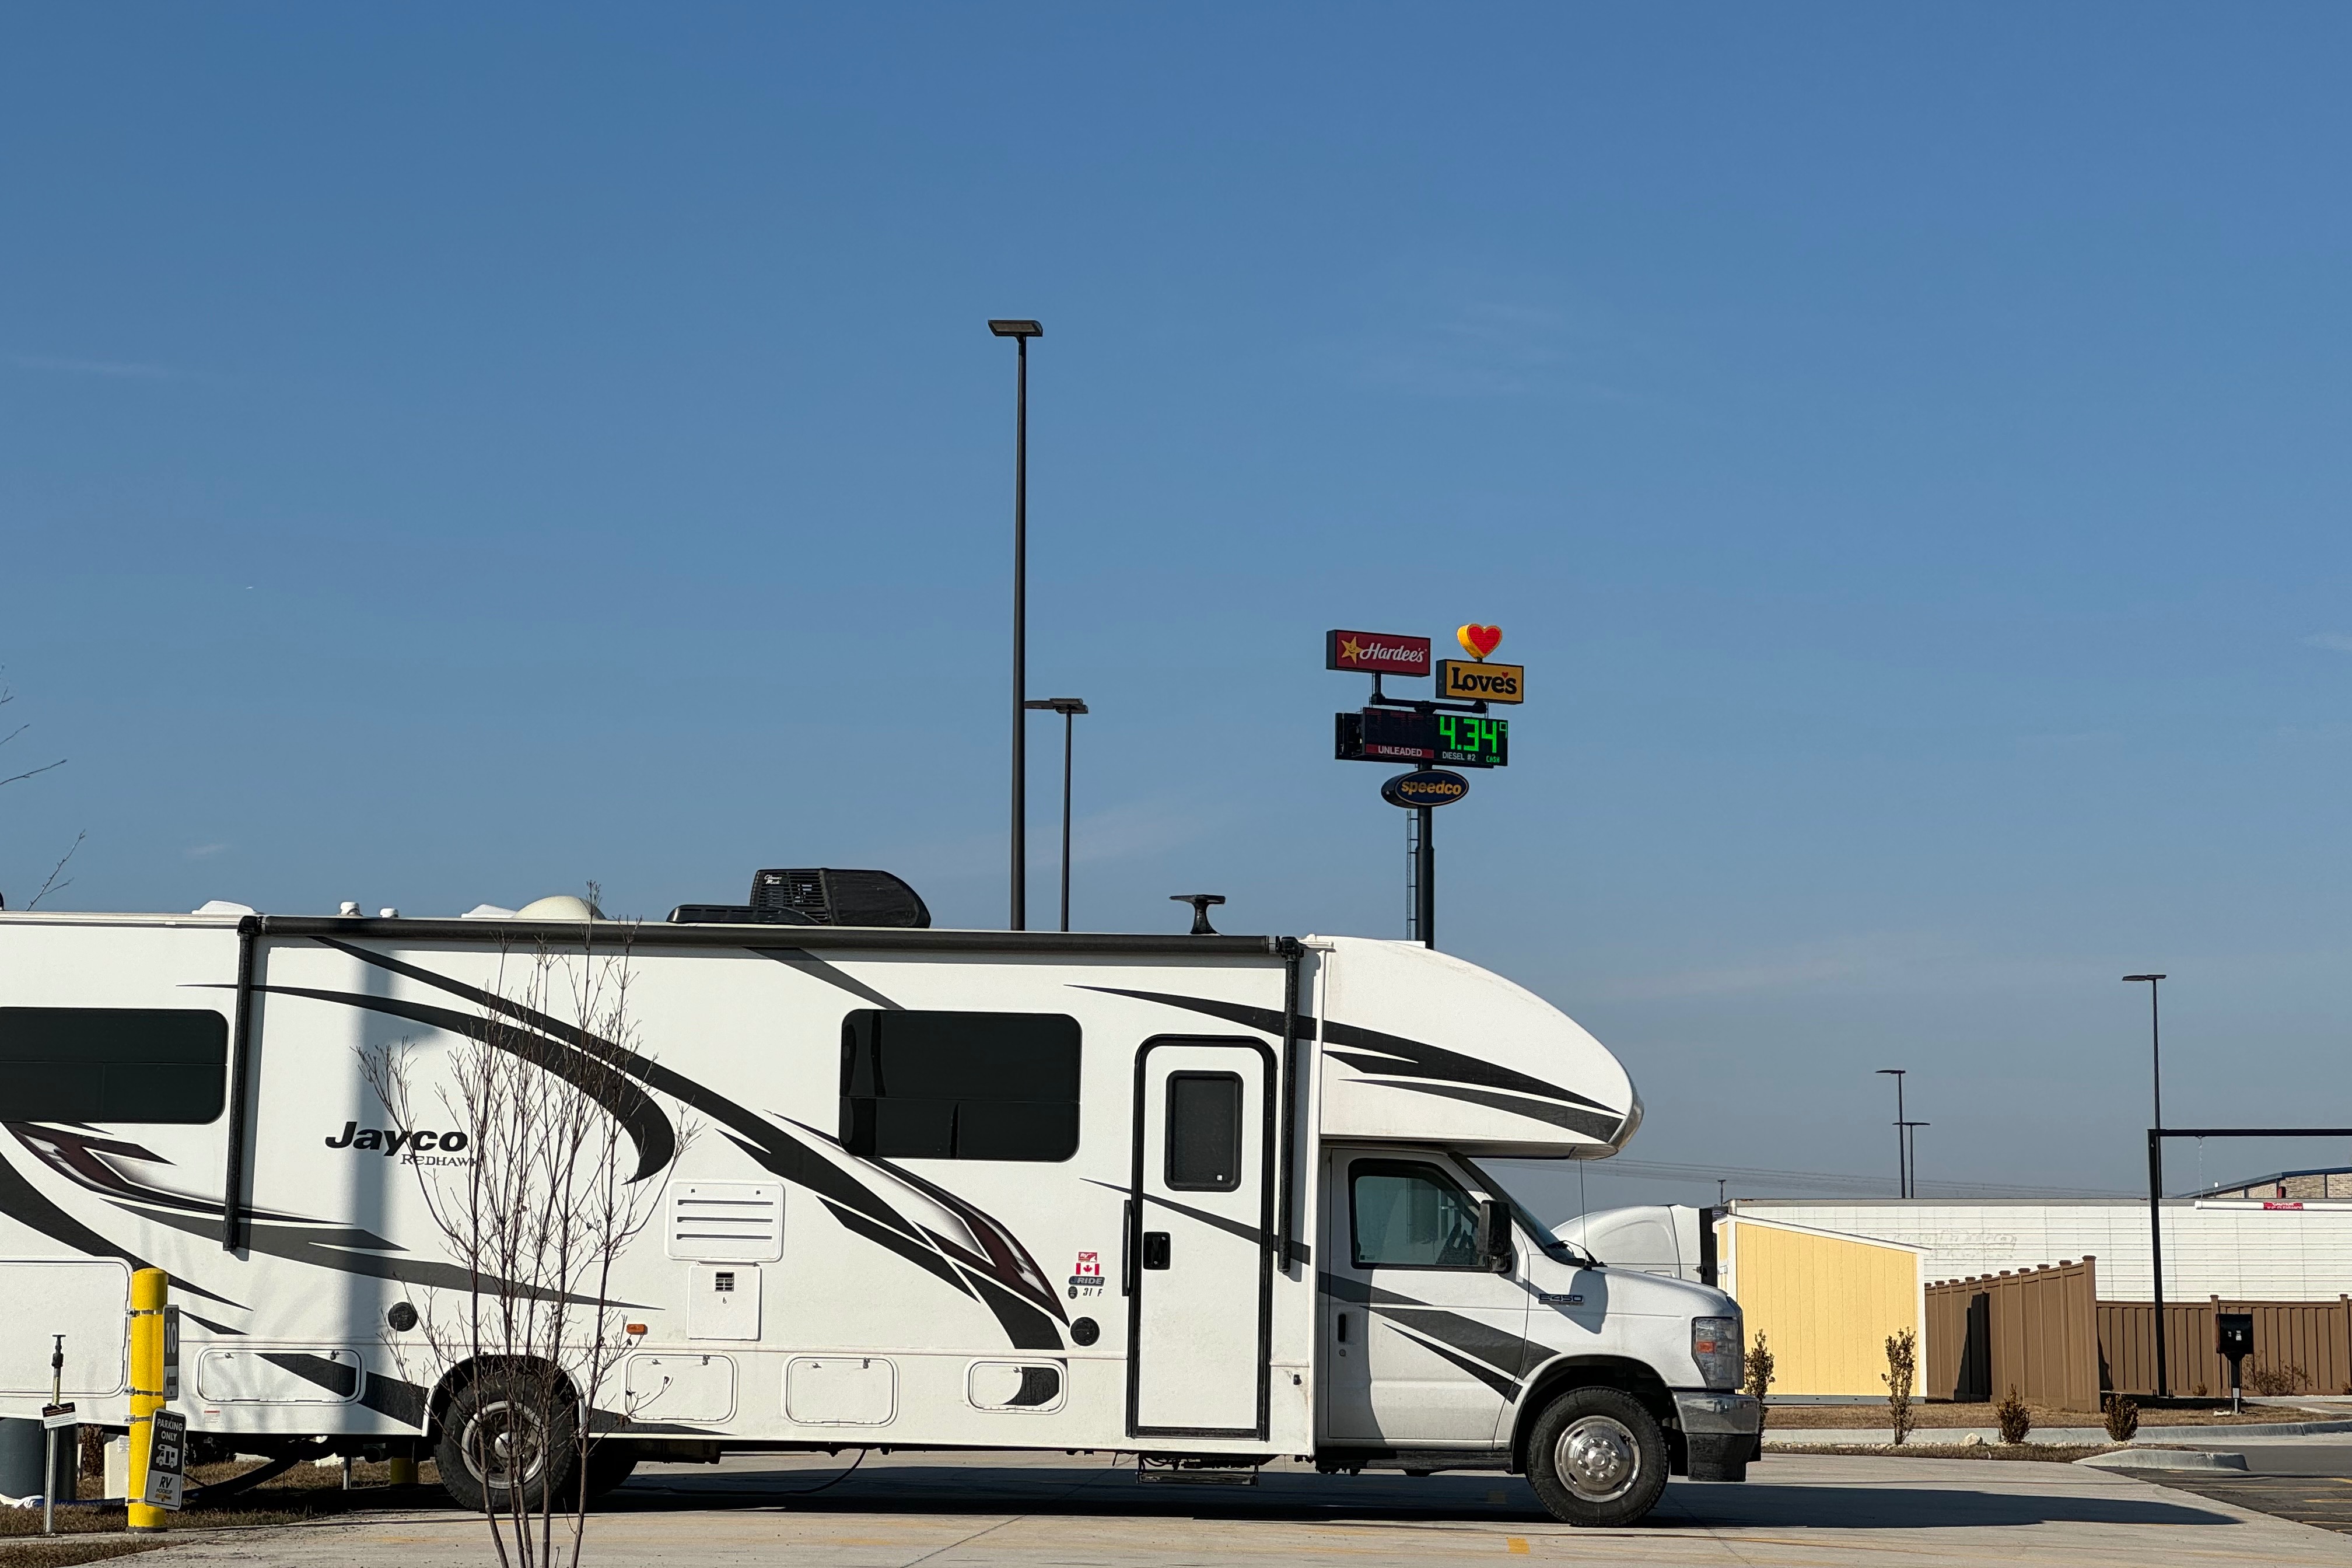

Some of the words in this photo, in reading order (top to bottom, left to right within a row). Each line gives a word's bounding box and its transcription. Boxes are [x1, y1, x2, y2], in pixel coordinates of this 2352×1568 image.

[1360, 643, 1424, 663] Hardee's
[1378, 746, 1422, 757] UNLEADED
[1442, 751, 1465, 761] DIESEL
[1401, 780, 1462, 795] speedco
[325, 1121, 468, 1156] Jayco
[166, 1322, 177, 1354] 10
[156, 1418, 183, 1432] PARKING
[161, 1430, 177, 1442] ONLY
[159, 1476, 173, 1488] RV
